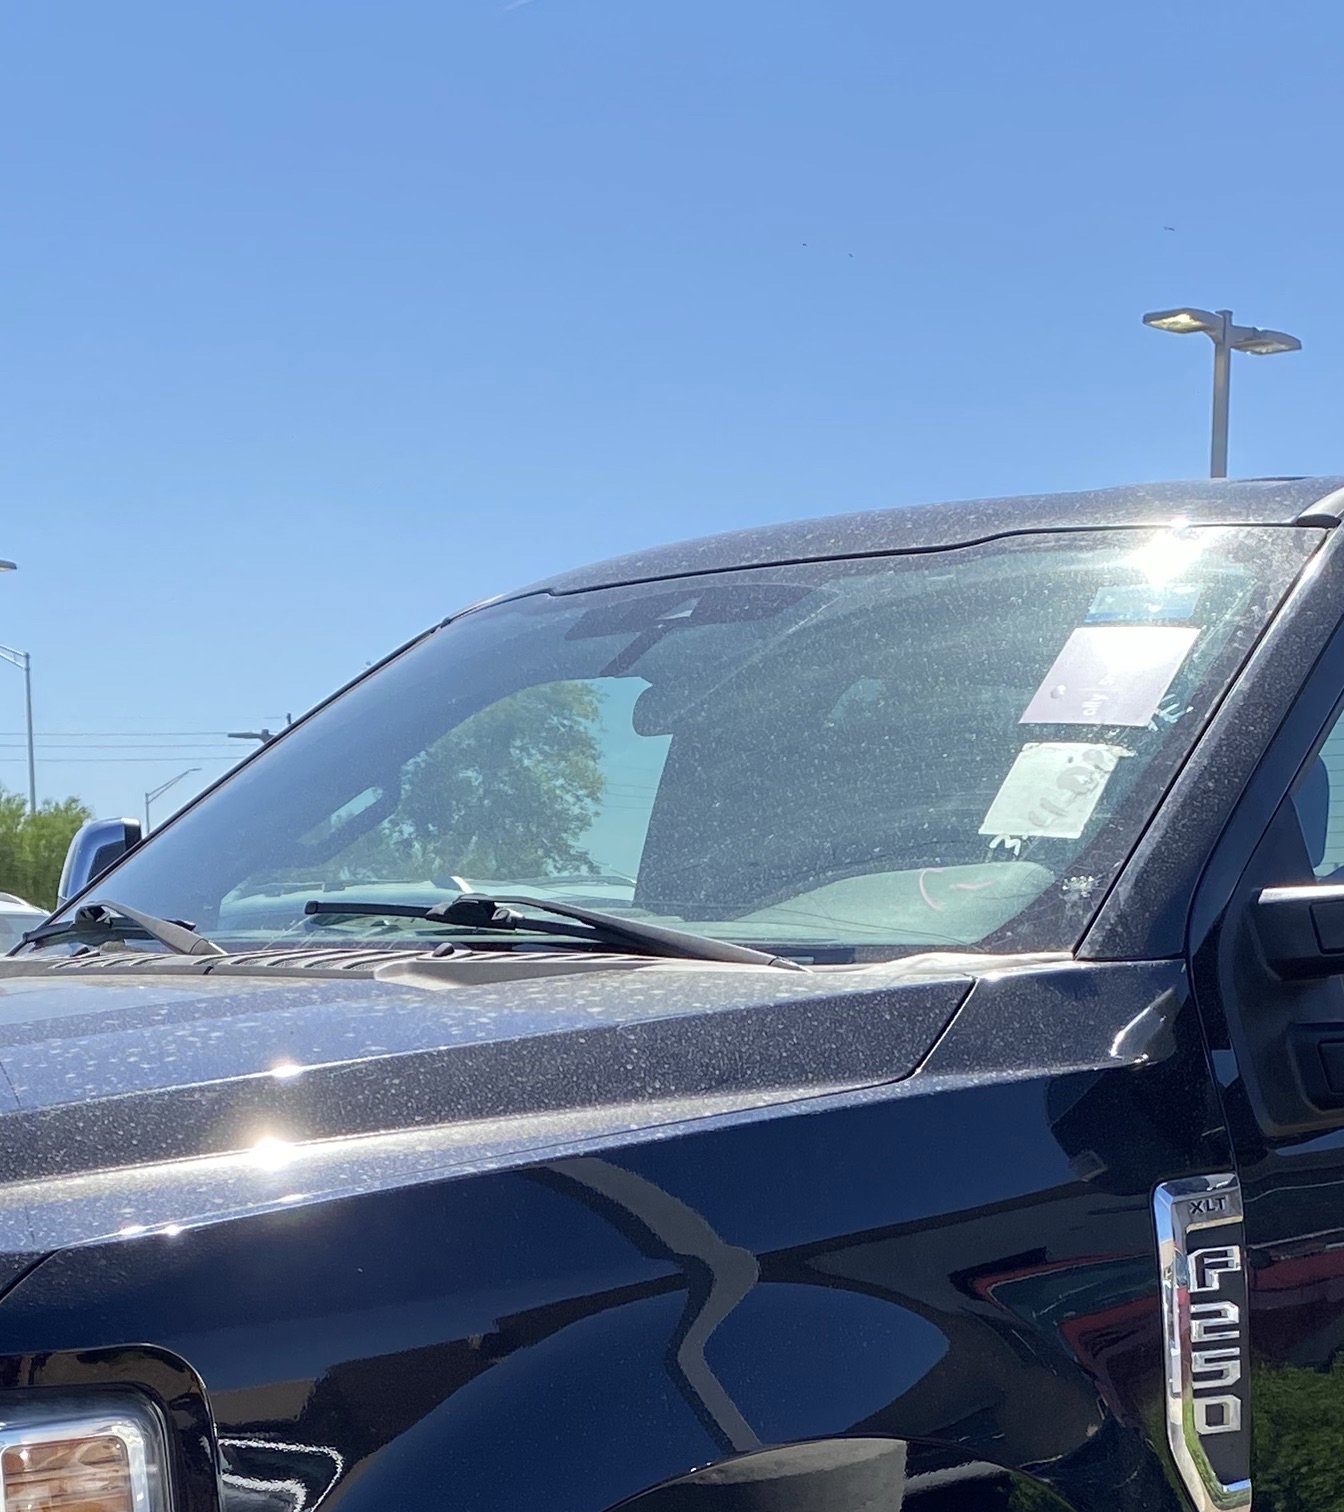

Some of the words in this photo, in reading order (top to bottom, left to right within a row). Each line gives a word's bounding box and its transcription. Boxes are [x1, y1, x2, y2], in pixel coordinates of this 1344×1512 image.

[1081, 693, 1110, 717] ally
[1189, 1197, 1228, 1216] XLT
[1187, 1245, 1242, 1436] F250
